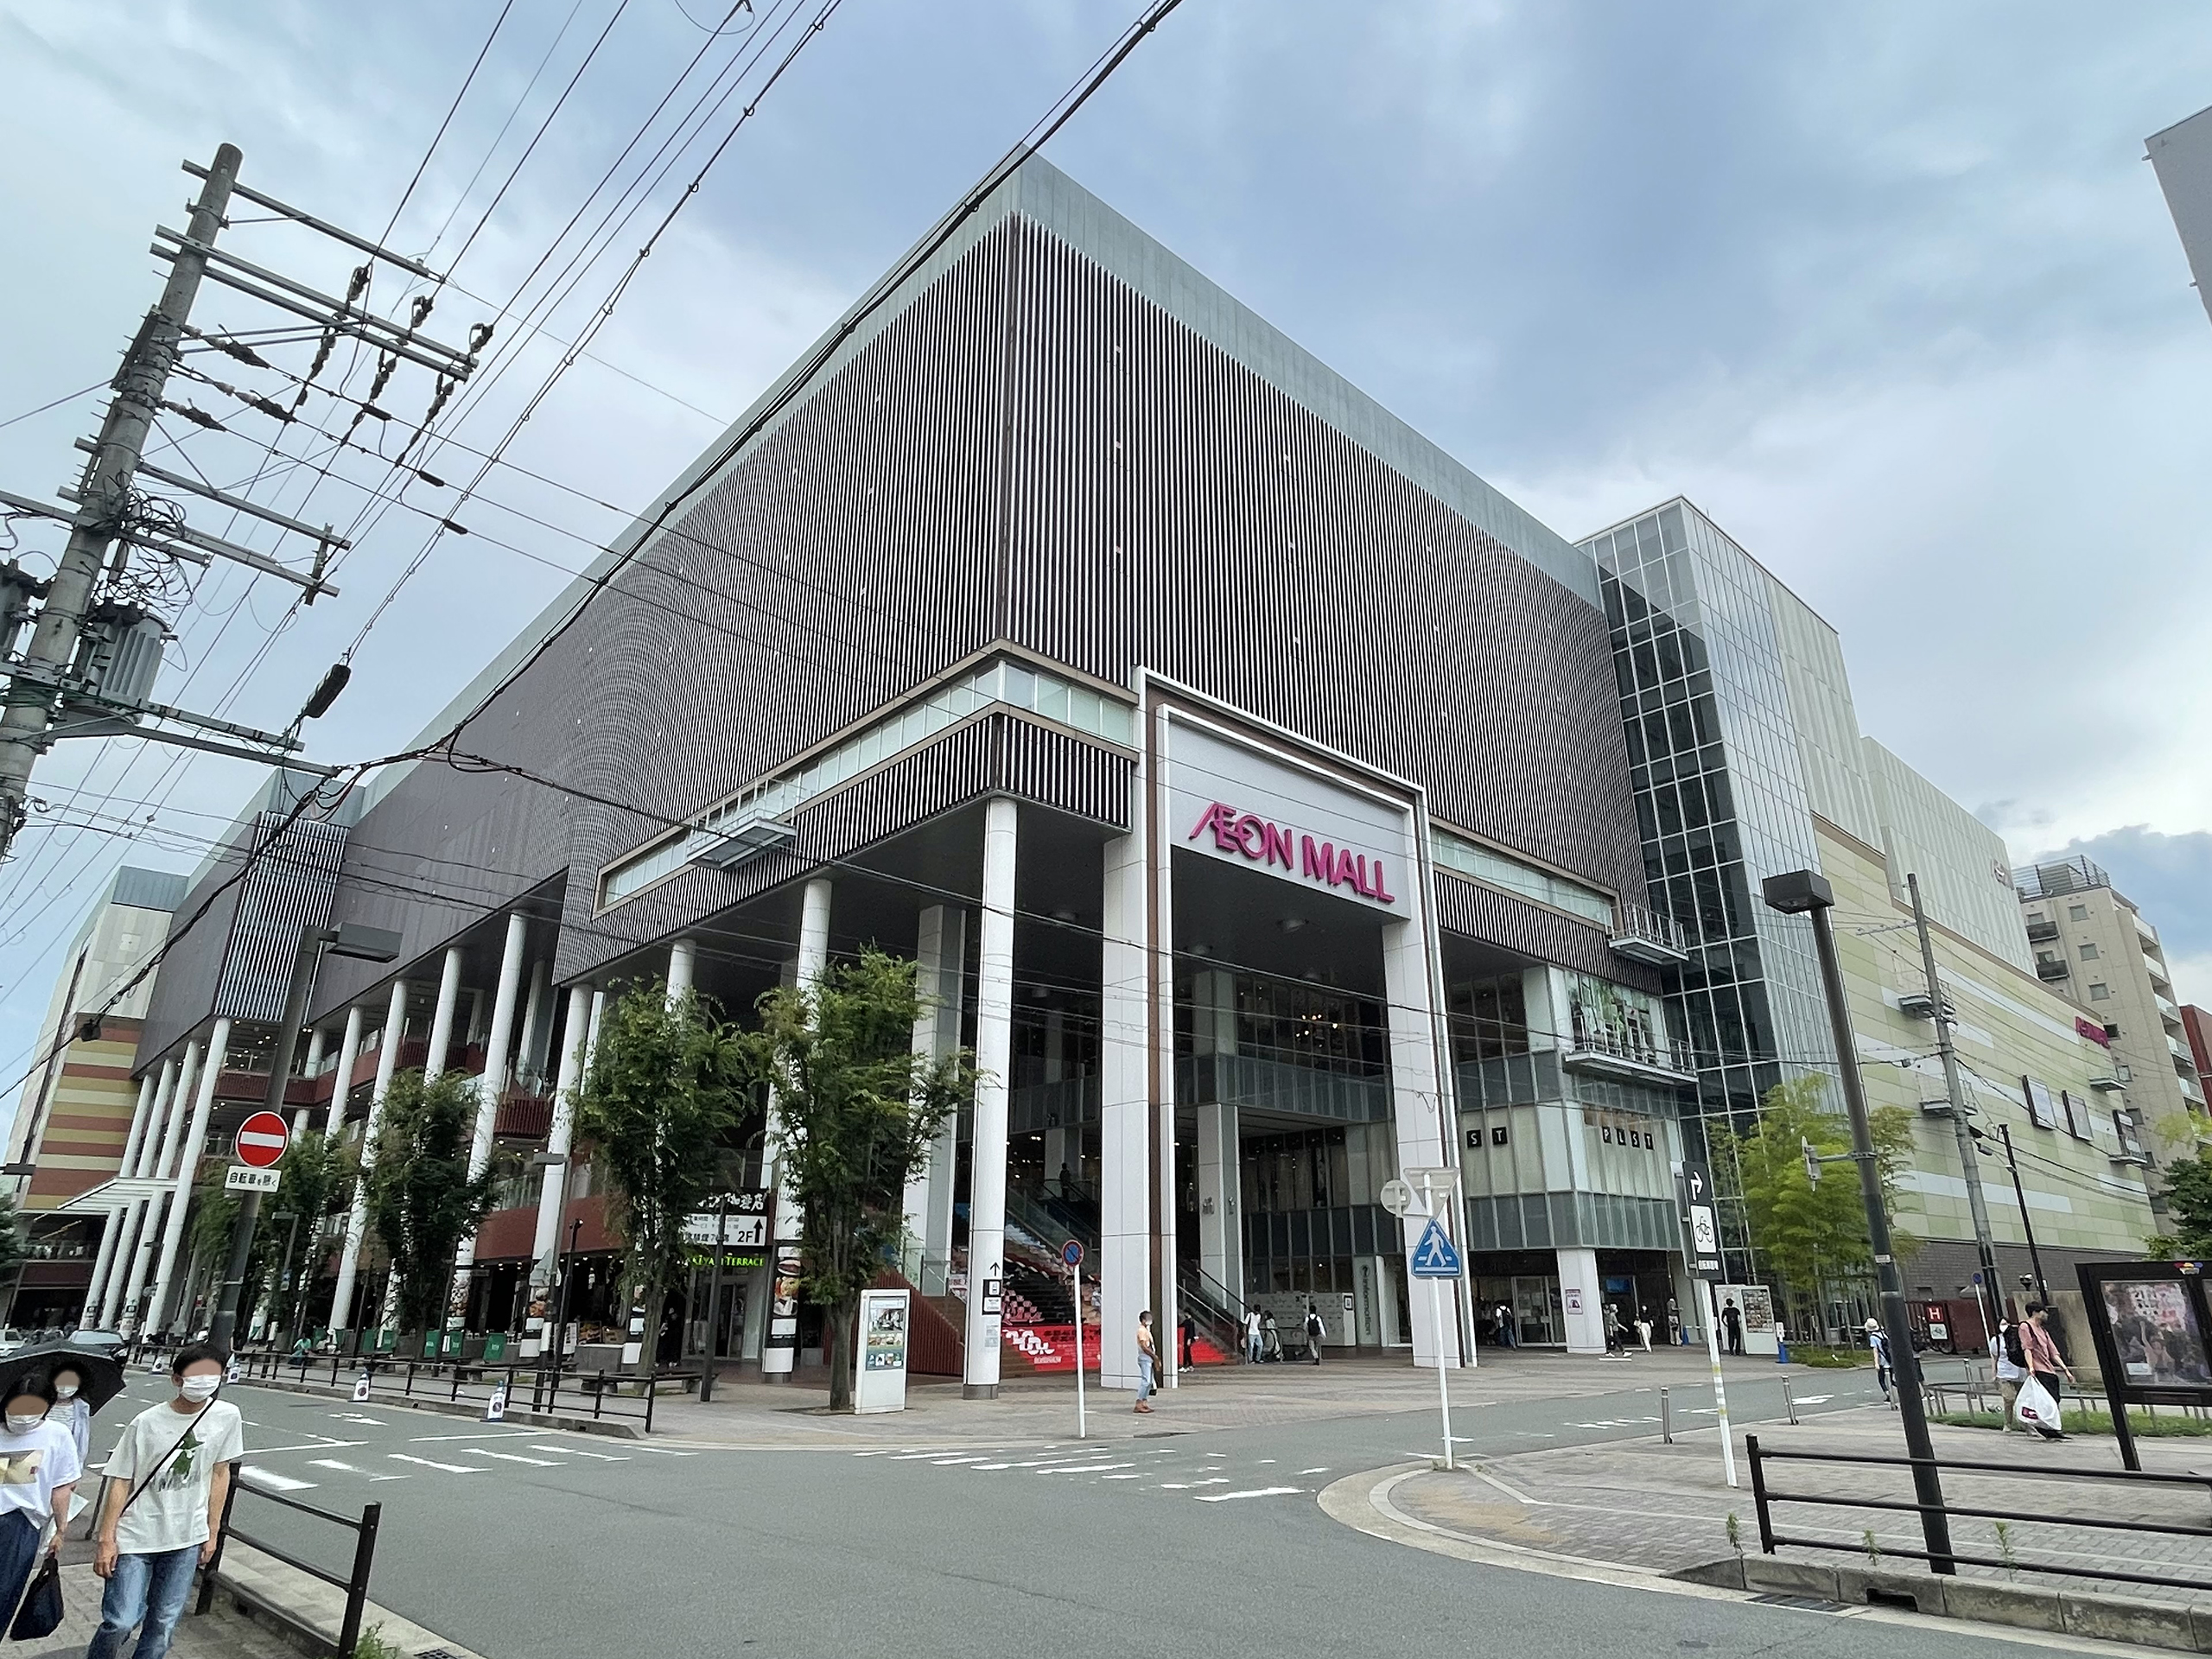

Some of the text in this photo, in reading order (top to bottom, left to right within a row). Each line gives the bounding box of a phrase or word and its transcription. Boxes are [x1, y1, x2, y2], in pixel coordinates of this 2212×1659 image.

[1302, 835, 1395, 903] MALL
[229, 1172, 277, 1187] 自転車を除く
[737, 1230, 753, 1243] 2F
[726, 1256, 764, 1267] TERRACE
[1929, 1307, 1941, 1320] H
